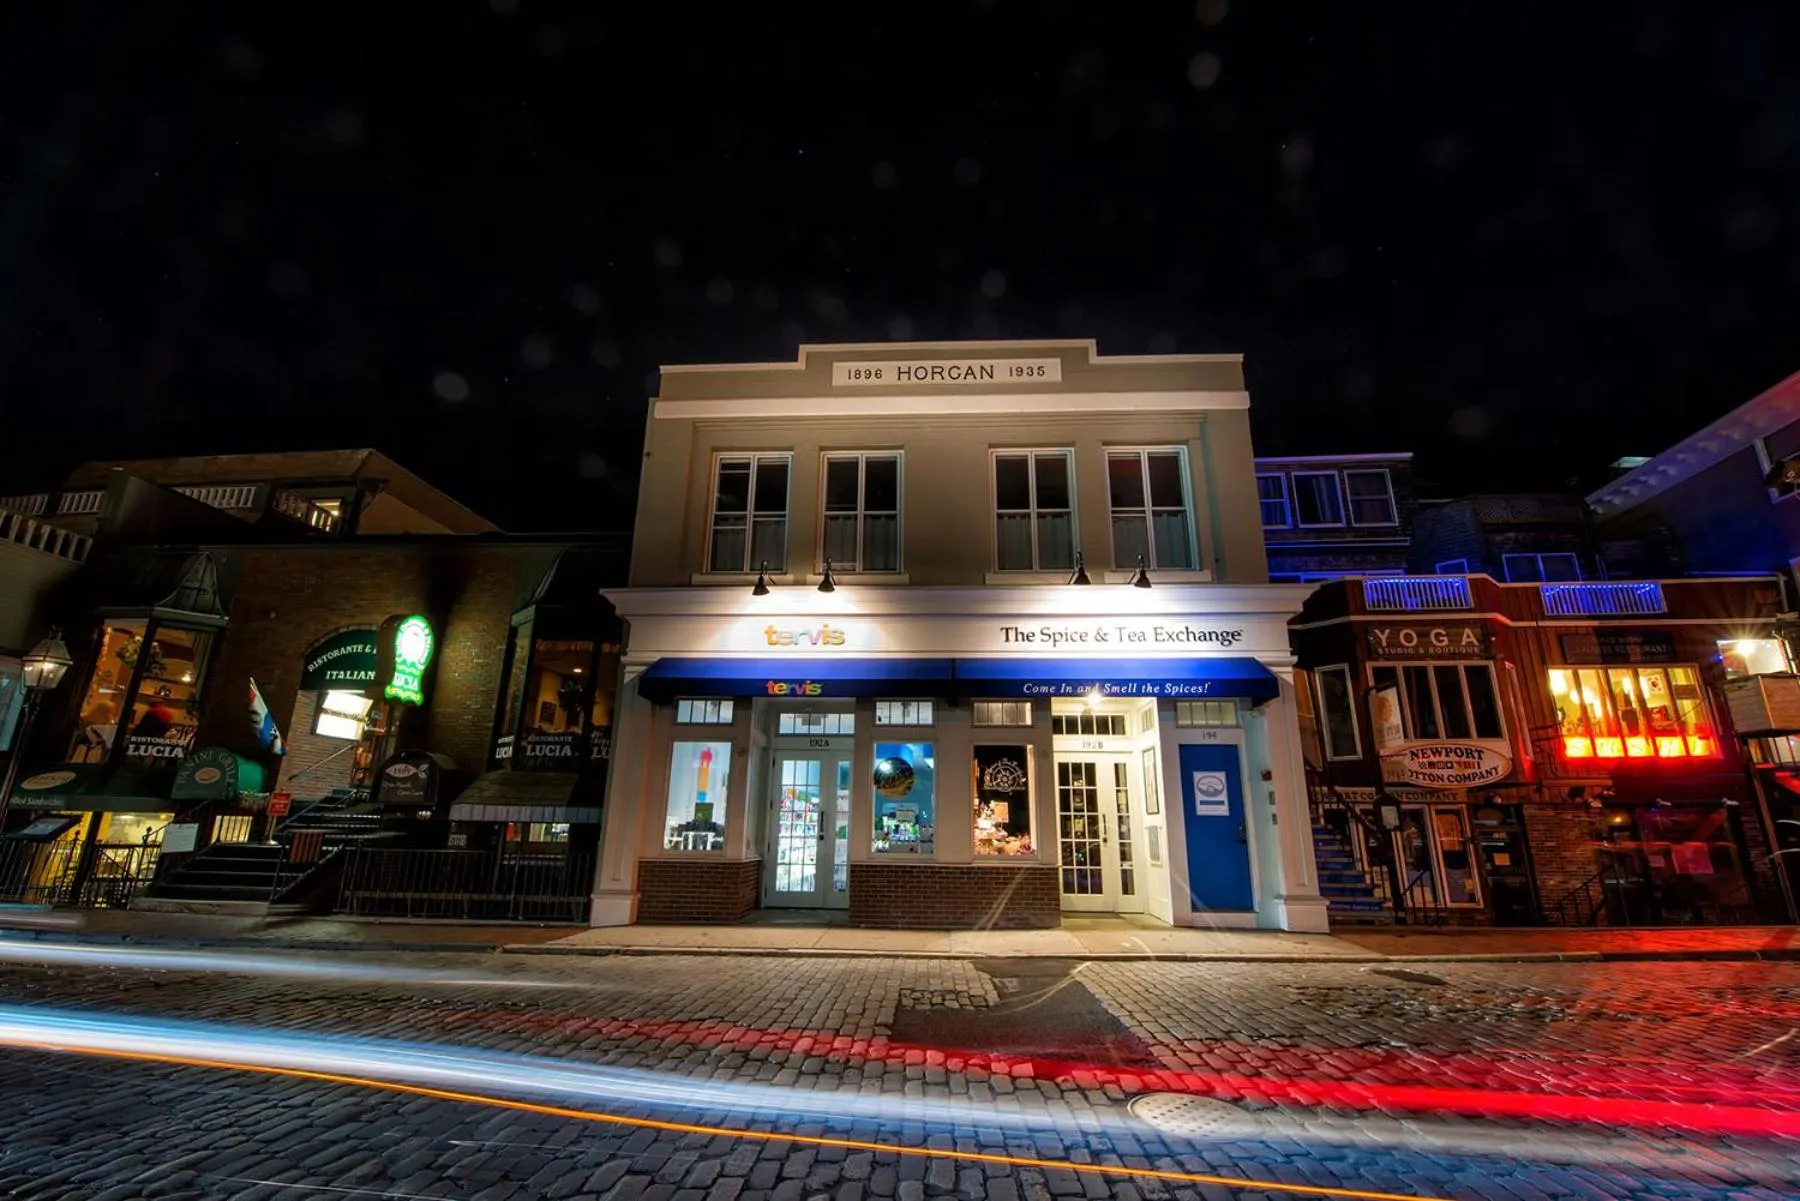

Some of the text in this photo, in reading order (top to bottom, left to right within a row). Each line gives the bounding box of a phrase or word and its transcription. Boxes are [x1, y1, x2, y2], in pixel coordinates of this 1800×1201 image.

[848, 364, 1046, 381] 1896 HORGAN 1935
[764, 623, 845, 646] tervis
[1000, 626, 1243, 647] The Spice & Tea Exchange
[1373, 628, 1480, 647] YOGA
[306, 644, 363, 672] RISTORANTE
[364, 644, 372, 653] &
[325, 670, 376, 681] ITALIAN
[766, 680, 822, 696] tervis
[1023, 683, 1056, 694] Come
[1060, 683, 1074, 694] In
[1103, 682, 1137, 694] Smell
[1141, 682, 1161, 694] the
[1164, 682, 1209, 695] Spices!
[1201, 730, 1218, 740] 194
[526, 744, 573, 757] LUCIA
[808, 738, 830, 748] 192A
[126, 744, 185, 758] LUCIA
[1410, 747, 1485, 761] NEWPORT
[1446, 764, 1500, 783] COMPANY
